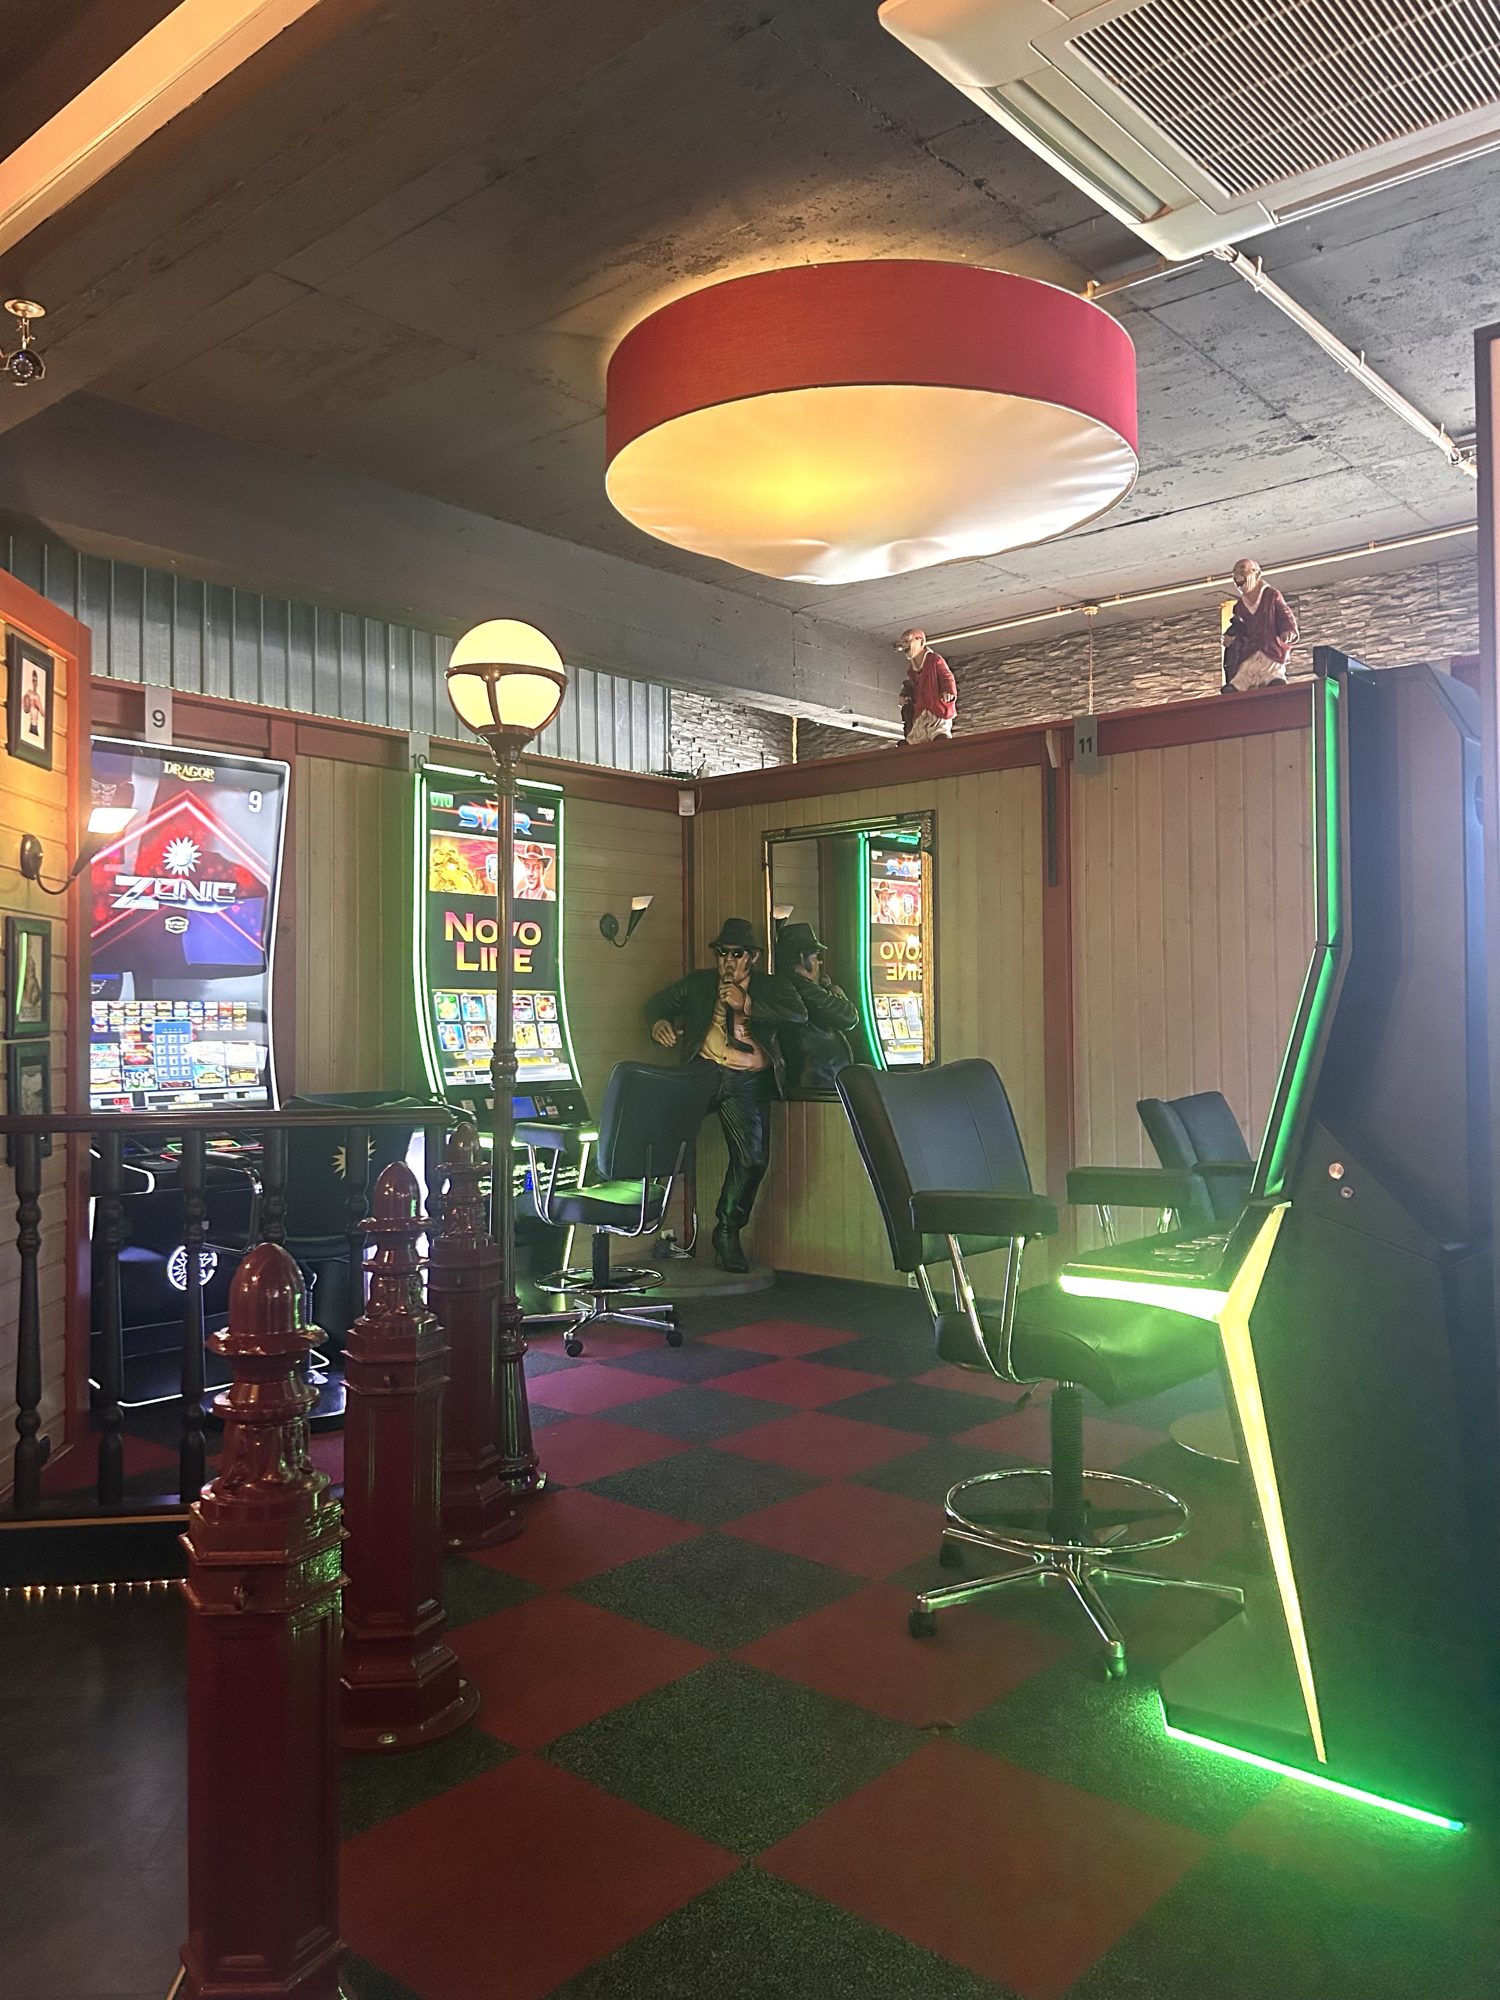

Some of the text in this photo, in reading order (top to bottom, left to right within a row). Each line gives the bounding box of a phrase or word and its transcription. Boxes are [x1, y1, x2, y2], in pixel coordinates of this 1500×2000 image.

[152, 709, 166, 728] 9
[1078, 736, 1092, 754] 11
[410, 753, 428, 769] 10
[248, 790, 263, 813] 9
[458, 804, 532, 836] STR
[111, 874, 237, 911] ZONIC
[445, 911, 542, 946] NOO
